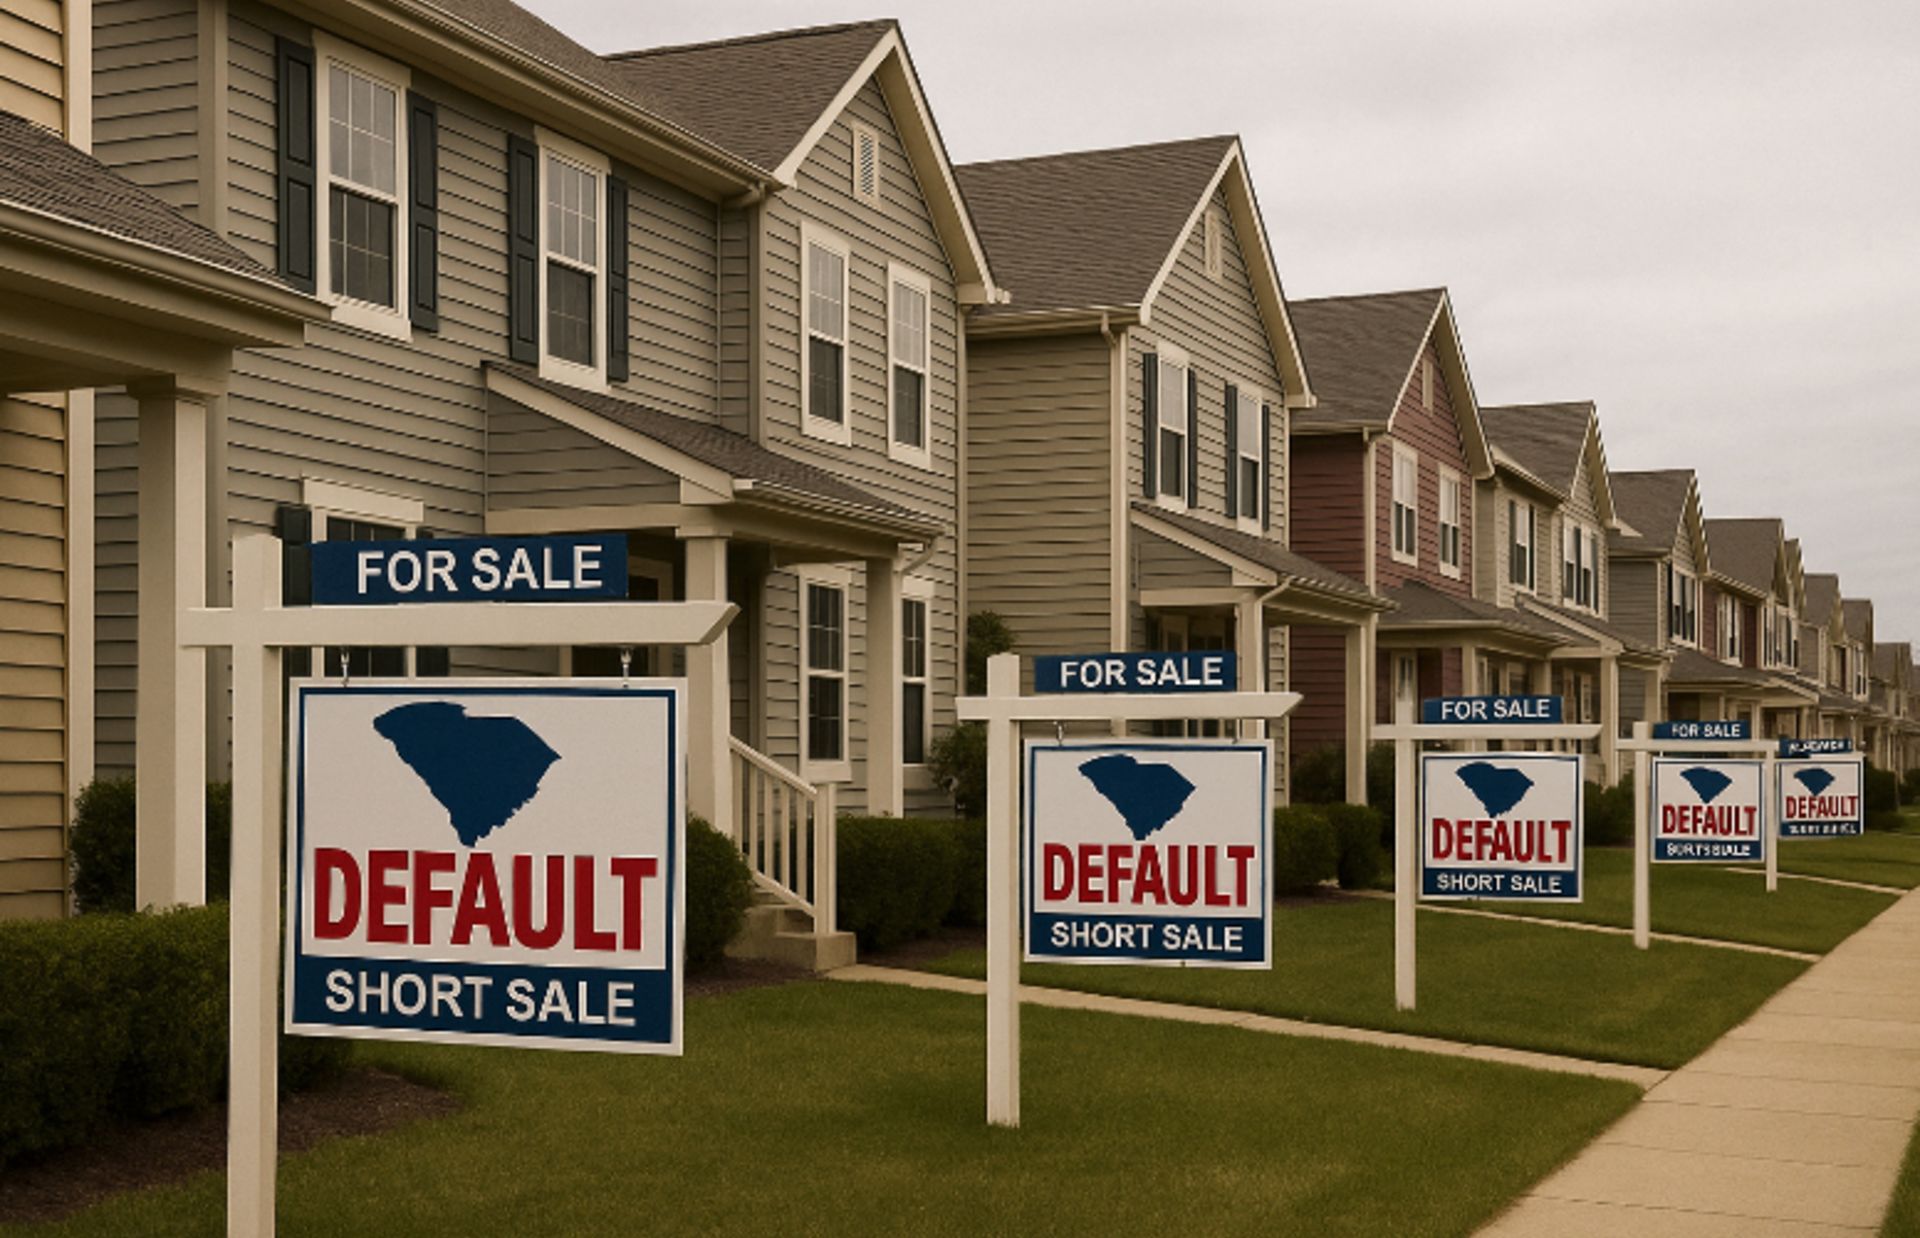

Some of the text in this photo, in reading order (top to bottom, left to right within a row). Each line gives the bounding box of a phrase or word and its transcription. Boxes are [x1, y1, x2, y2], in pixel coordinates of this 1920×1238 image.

[357, 545, 603, 595] FOR SALE
[1060, 656, 1223, 687] FOR SALE
[1441, 698, 1550, 720] FOR SALE
[1671, 723, 1741, 738] FOR SALE
[1662, 804, 1757, 836] DEFAULT
[1786, 795, 1858, 819] DEFAULT
[1432, 818, 1571, 863] DEFAULT
[1043, 843, 1255, 907] DEFAULT
[1436, 874, 1562, 893] SHORT SALE
[313, 848, 658, 952] DEFAULT
[1050, 922, 1243, 952] SHORT SALE
[325, 969, 636, 1027] SHORT SALE
